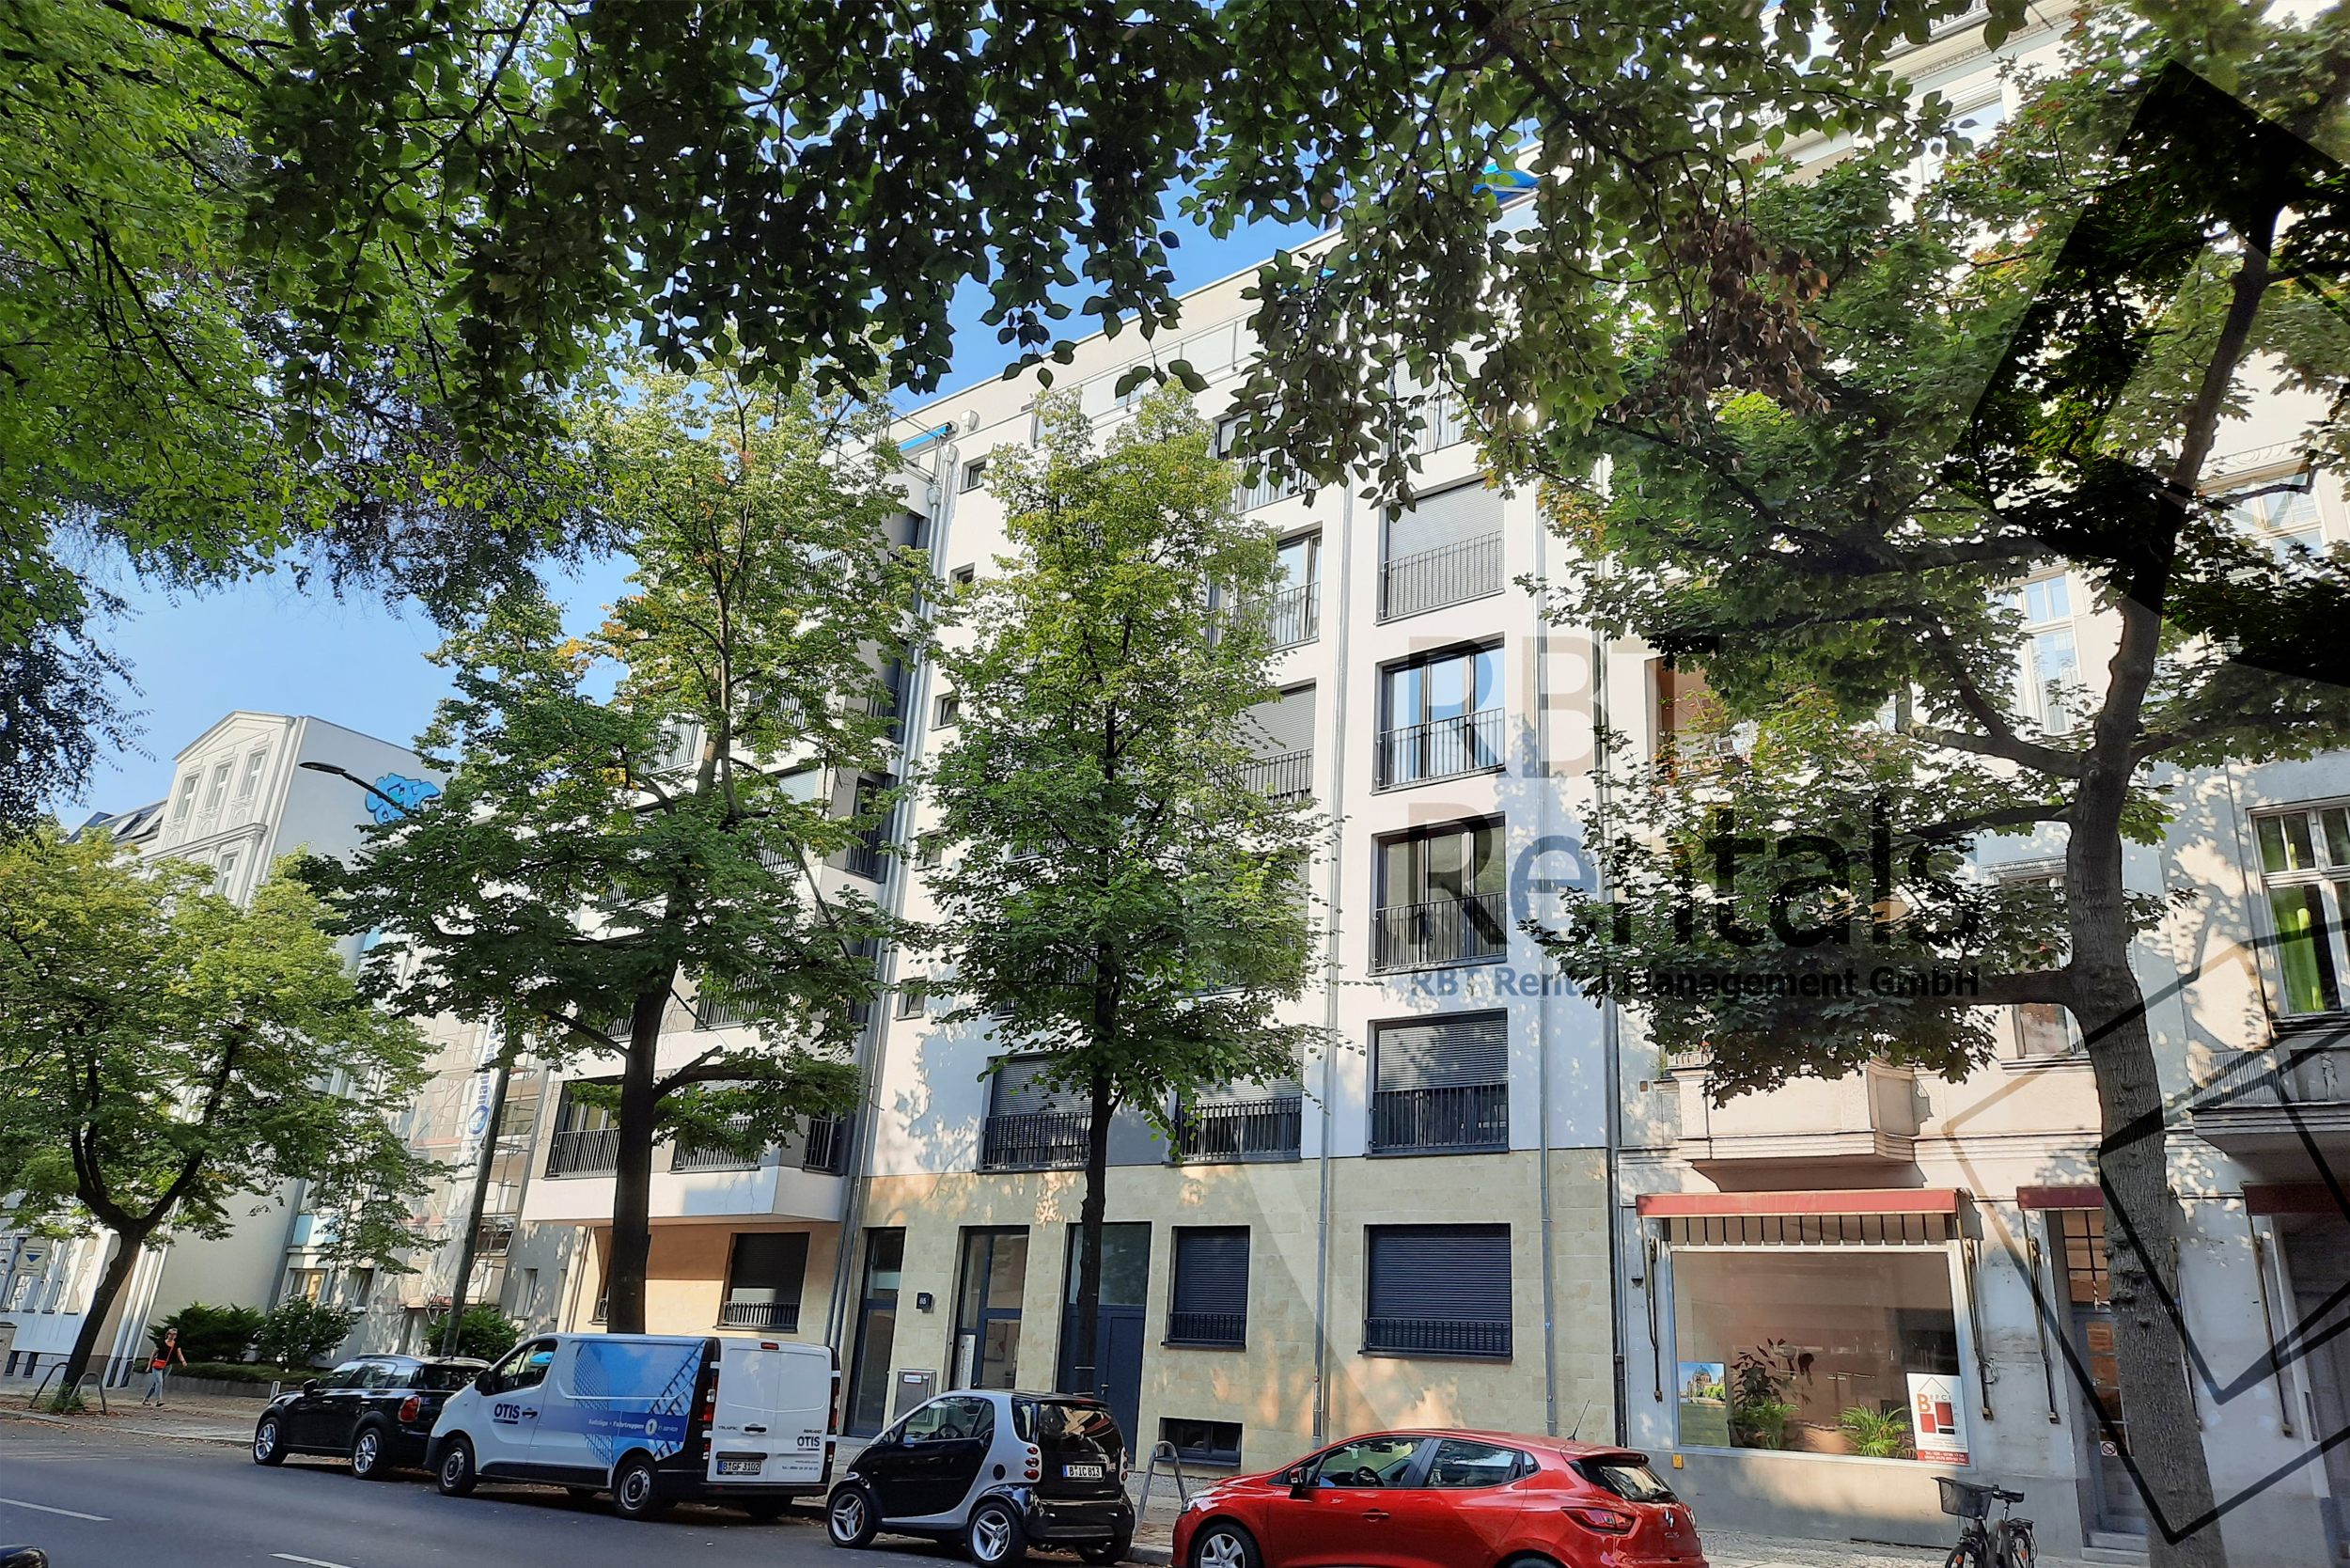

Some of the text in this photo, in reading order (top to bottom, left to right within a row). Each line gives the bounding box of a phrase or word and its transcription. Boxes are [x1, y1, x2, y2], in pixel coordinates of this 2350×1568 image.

[494, 1403, 521, 1419] OTIS
[797, 1435, 821, 1448] OTIS
[1069, 1466, 1074, 1476] B
